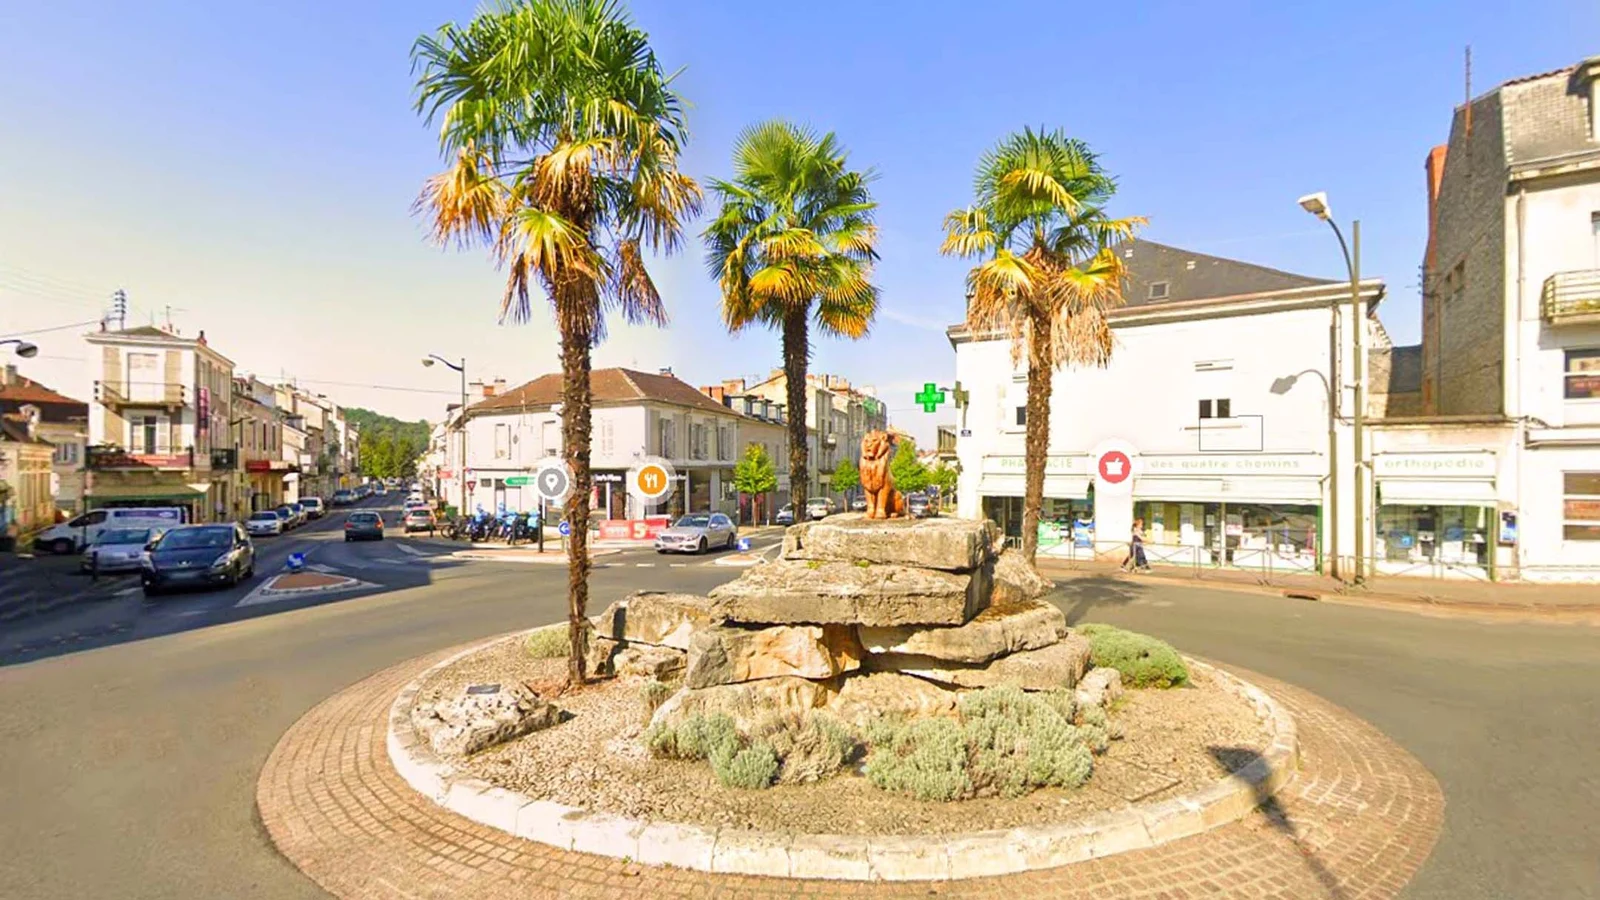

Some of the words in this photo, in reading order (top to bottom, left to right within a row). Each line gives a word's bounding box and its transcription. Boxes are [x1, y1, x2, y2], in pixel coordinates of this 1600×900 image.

[1000, 458, 1073, 468] PHAACIE
[1150, 459, 1174, 468] des
[1181, 459, 1229, 469] quatre
